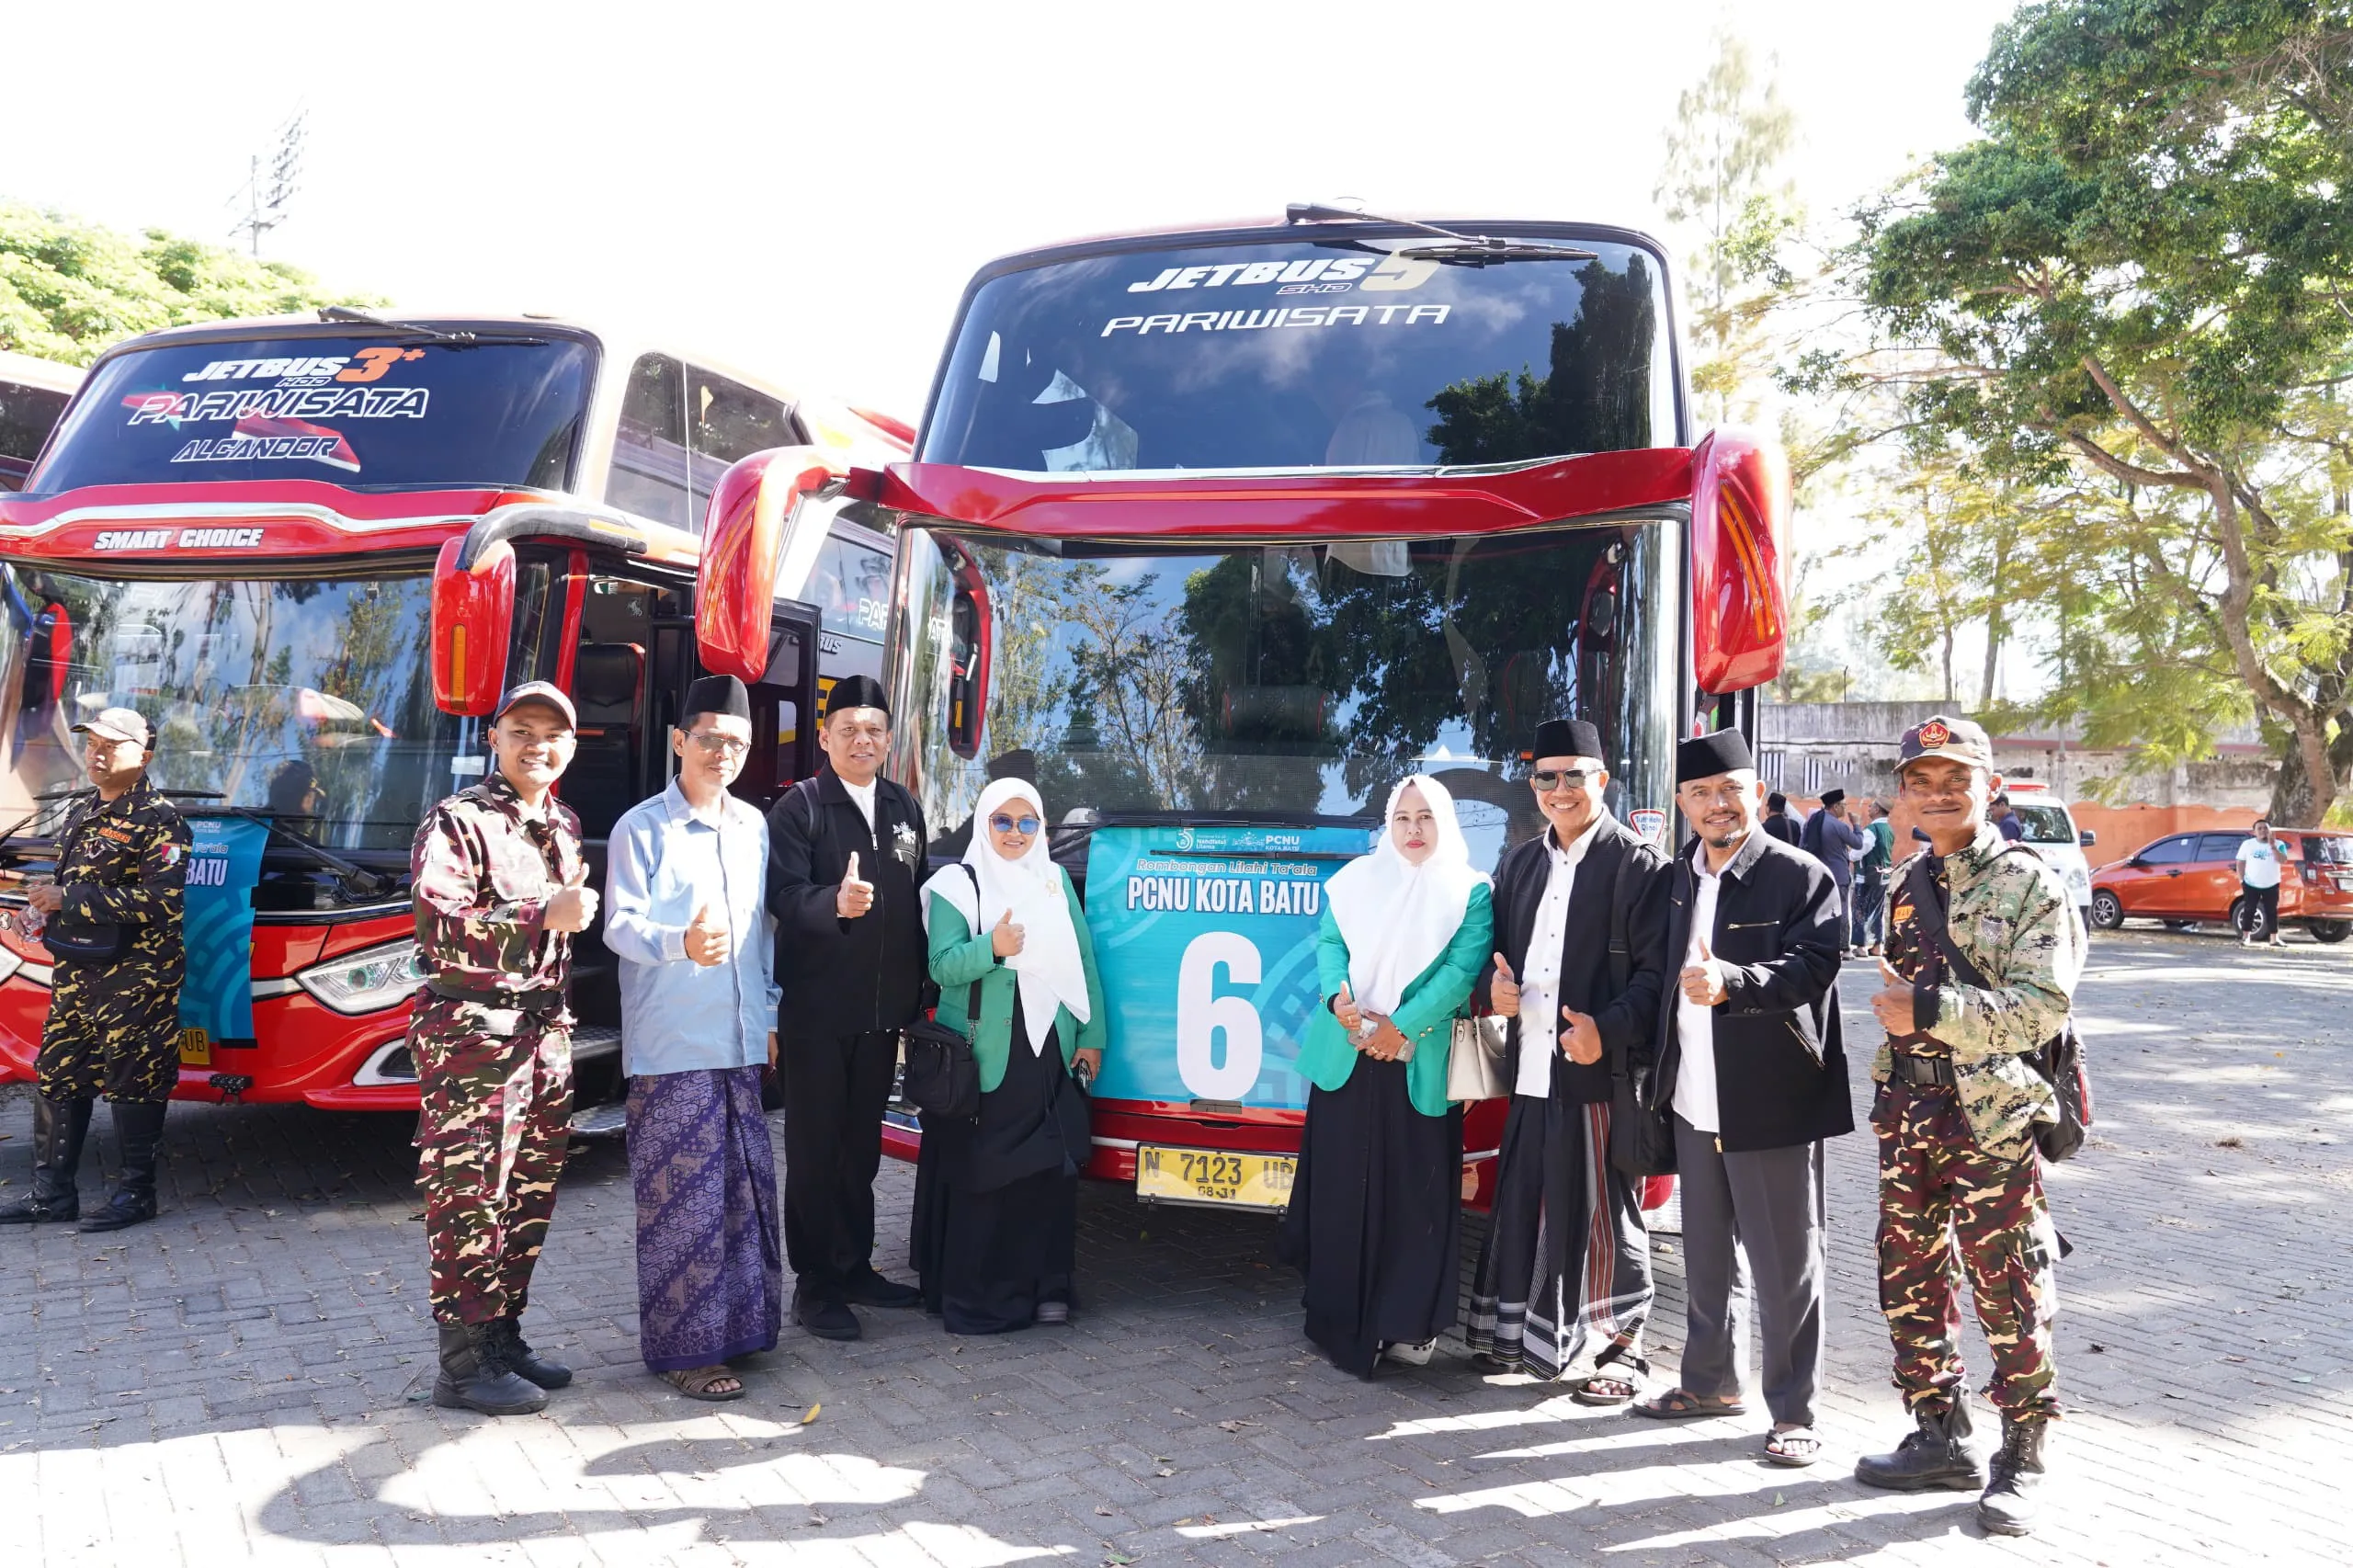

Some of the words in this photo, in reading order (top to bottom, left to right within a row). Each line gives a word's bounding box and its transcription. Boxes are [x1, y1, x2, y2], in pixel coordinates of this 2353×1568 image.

[1127, 257, 1376, 292] JETBUS
[1276, 282, 1352, 295] SHD
[1101, 304, 1451, 337] PARIWISATA
[182, 357, 351, 382] JETBUS
[275, 377, 332, 387] HDD
[127, 387, 430, 426] PARIWISATA
[94, 528, 173, 550] SMART
[177, 528, 264, 548] CHOICE
[1266, 835, 1300, 846] PCNU
[186, 858, 229, 886] BATU
[1137, 858, 1226, 874] Rombongan
[1229, 860, 1267, 874] Lilahi
[1127, 875, 1189, 911] PCNU
[1194, 877, 1253, 913] KOTA
[1258, 880, 1321, 916] BATU
[1176, 931, 1263, 1100] 6
[1145, 1152, 1160, 1178] N
[1180, 1153, 1242, 1186] 7123
